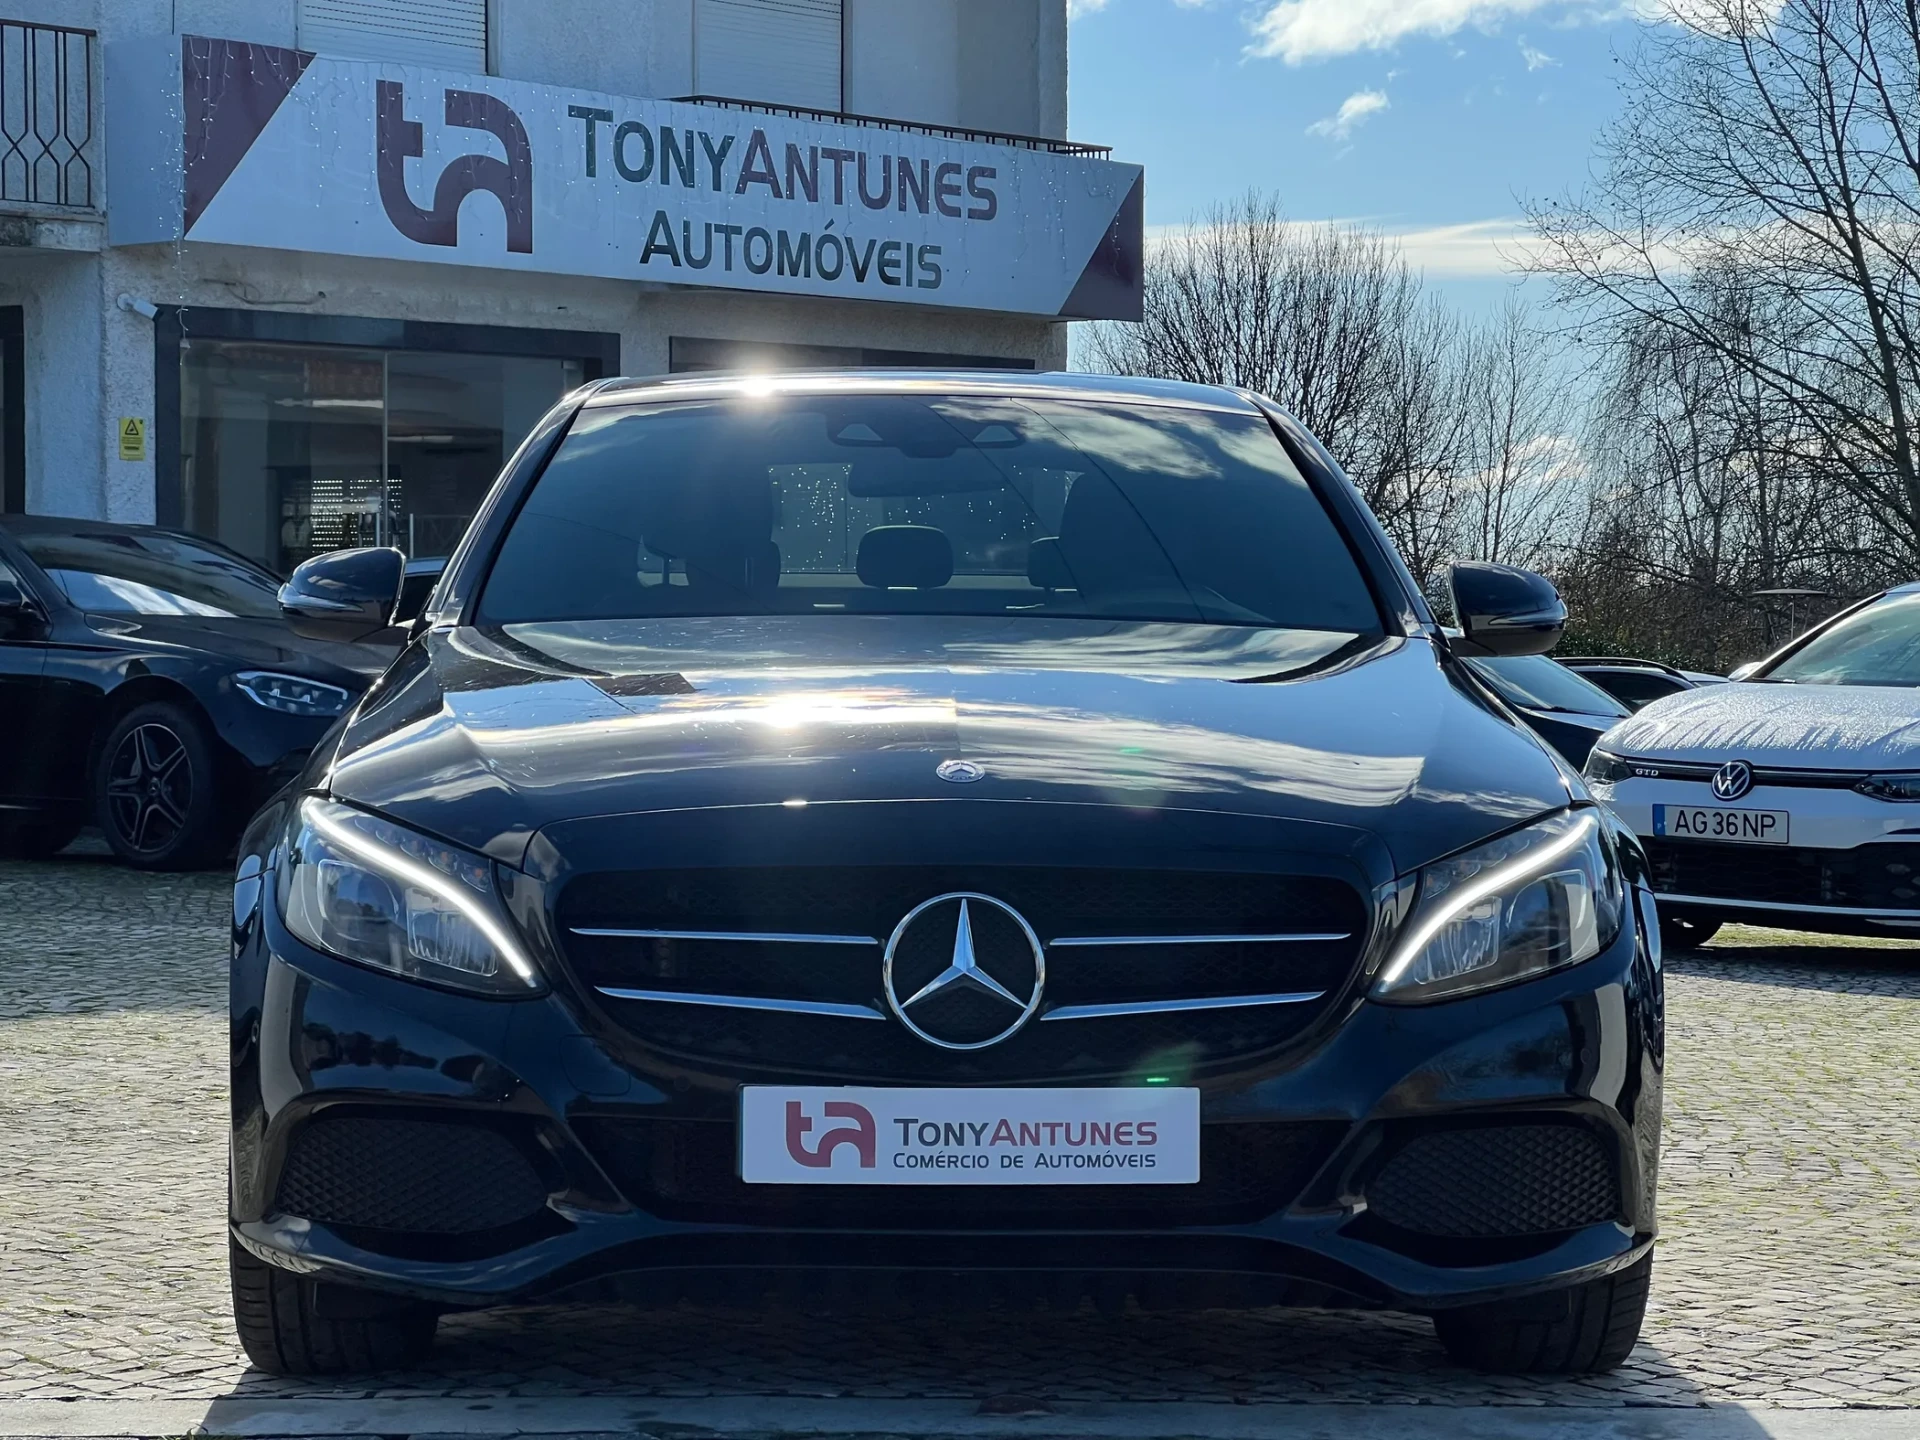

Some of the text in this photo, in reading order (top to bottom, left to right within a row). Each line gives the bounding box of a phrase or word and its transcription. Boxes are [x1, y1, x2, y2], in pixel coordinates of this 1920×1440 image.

[639, 209, 942, 290] AUTOMÓVEIS
[1635, 767, 1659, 777] GTD
[893, 1149, 1156, 1169] COMÉRCIO DE AUTOMÓVEIS
